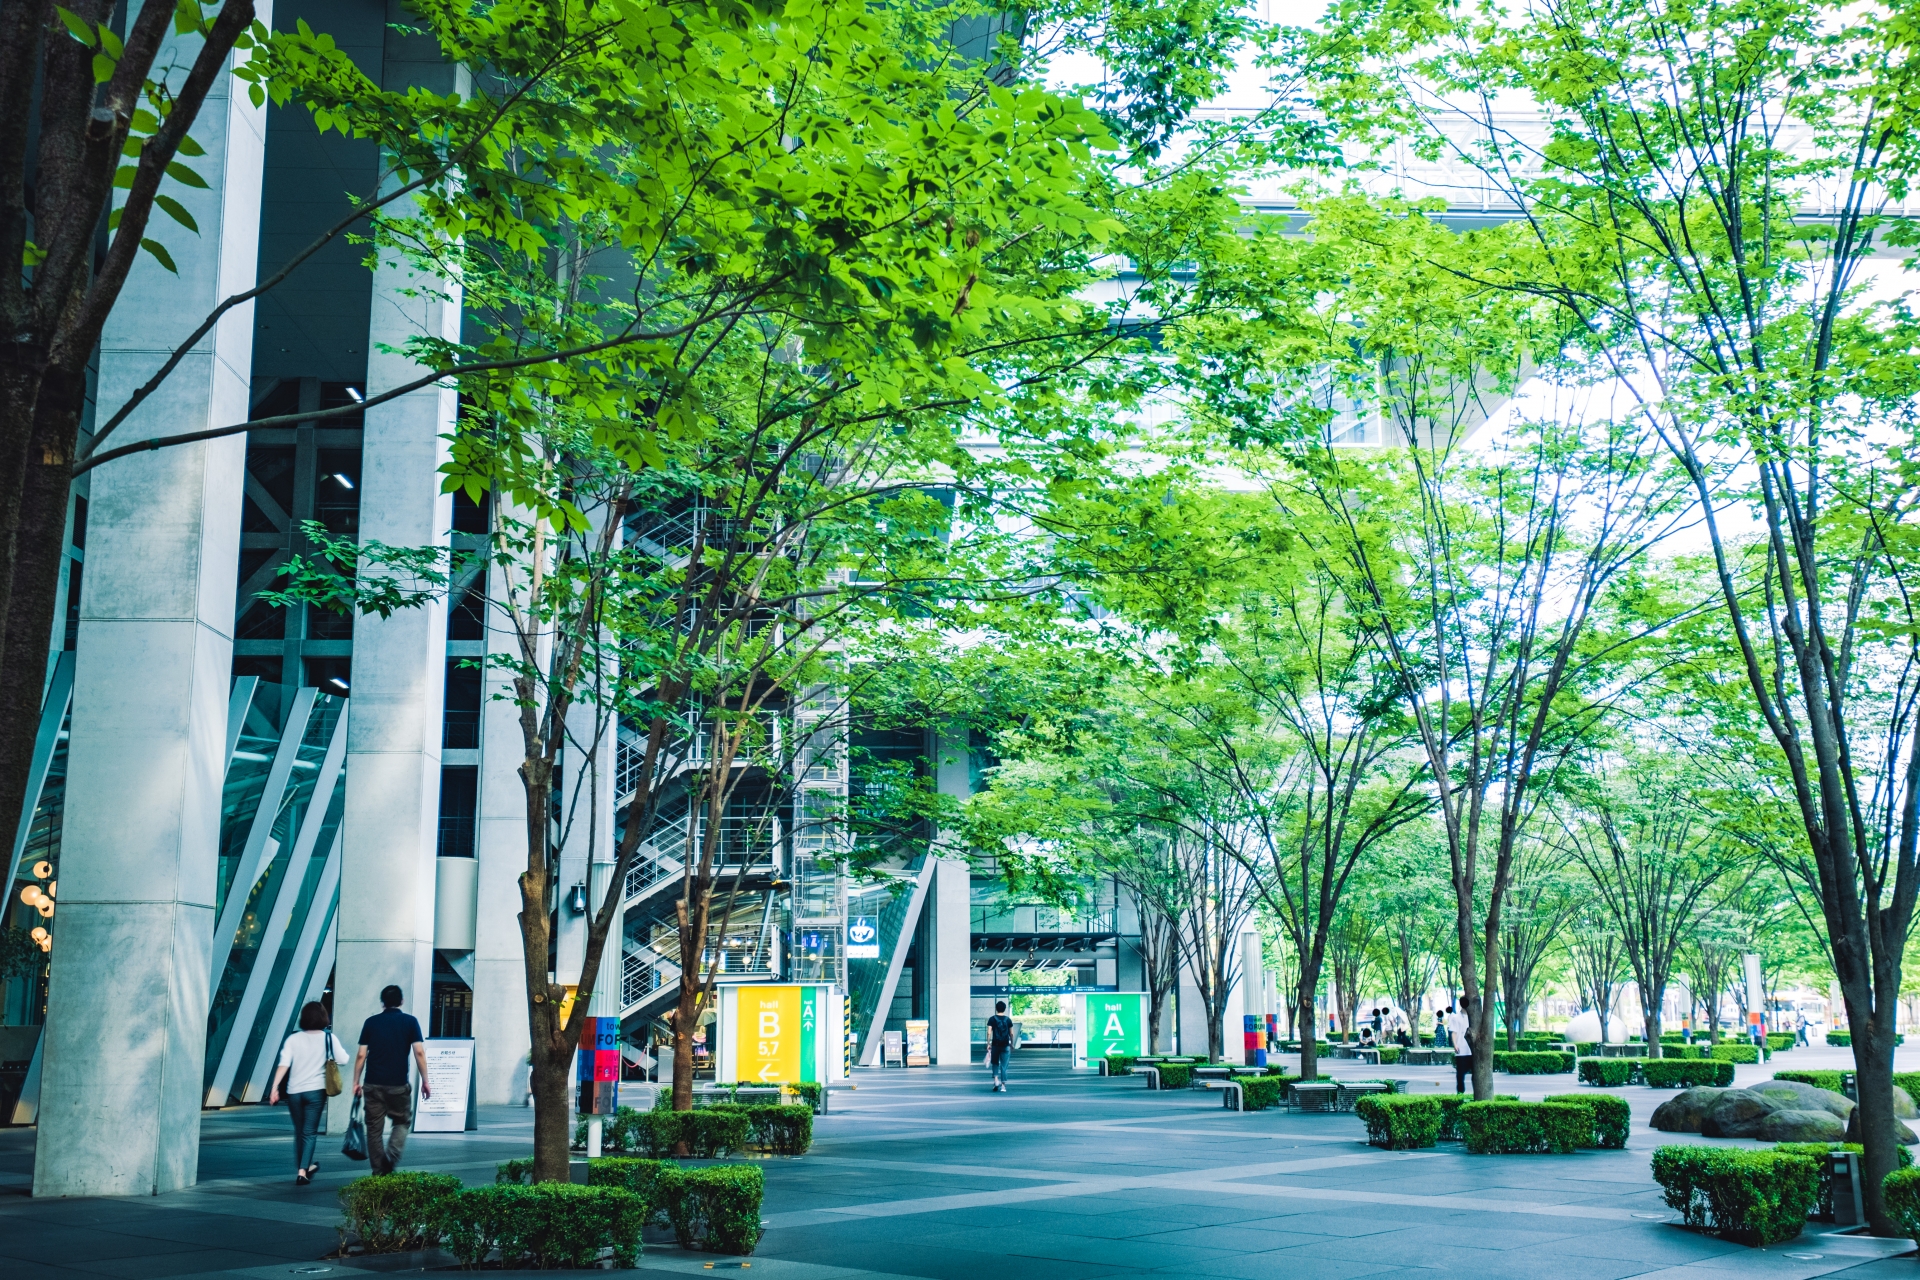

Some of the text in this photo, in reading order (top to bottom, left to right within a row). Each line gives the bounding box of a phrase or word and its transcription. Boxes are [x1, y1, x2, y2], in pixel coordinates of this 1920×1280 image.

[760, 1000, 779, 1009] hall
[1104, 1003, 1122, 1011] hall
[803, 1006, 814, 1018] A
[758, 1011, 781, 1038] B
[1103, 1012, 1125, 1036] A
[758, 1042, 779, 1056] 5,7
